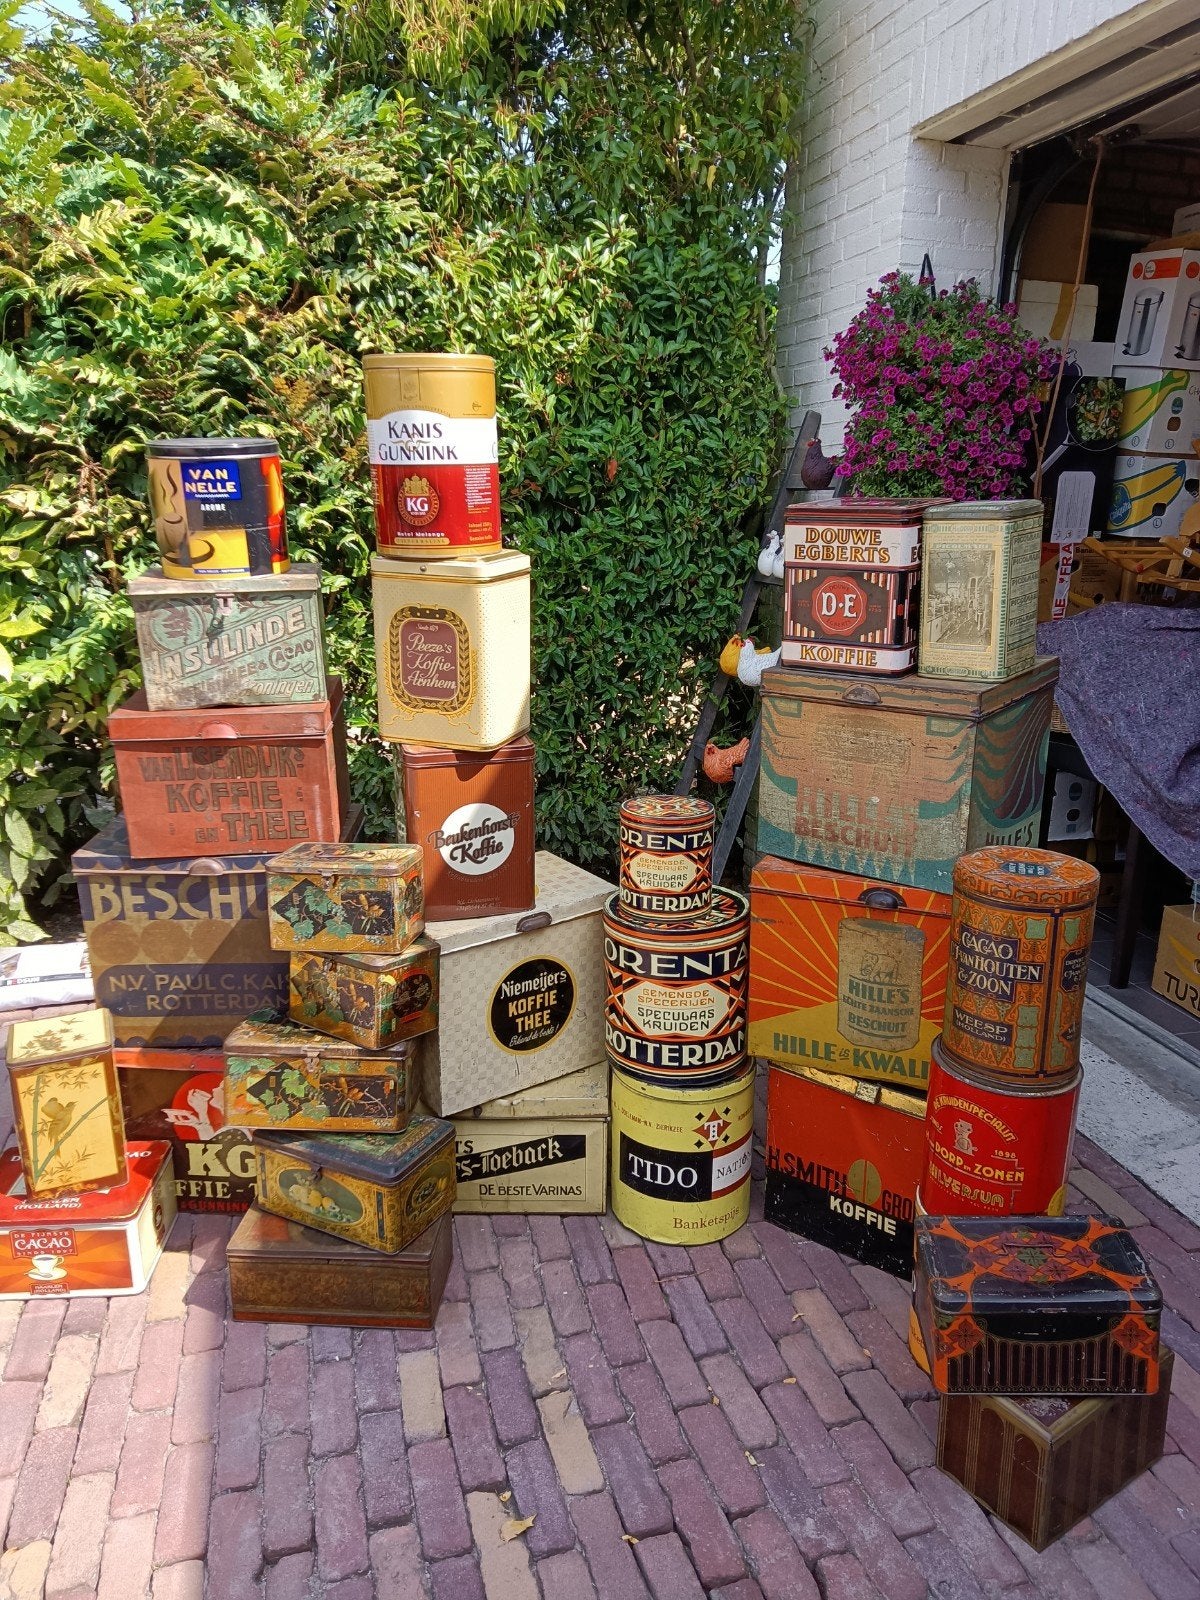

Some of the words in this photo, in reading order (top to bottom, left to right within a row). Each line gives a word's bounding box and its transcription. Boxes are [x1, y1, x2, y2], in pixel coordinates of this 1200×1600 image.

[387, 421, 443, 439] KANIS
[378, 443, 458, 461] GUNNINK
[188, 468, 229, 480] VAN
[184, 481, 238, 493] NELLE
[406, 497, 429, 512] KG
[805, 527, 882, 546] DOUWE
[794, 544, 891, 563] EGBERTS
[406, 632, 453, 654] Peeze's
[406, 651, 456, 679] Koffie
[800, 644, 878, 667] KOFFIE
[403, 670, 457, 690] Arnhem
[166, 780, 283, 813] KOFFIE
[194, 827, 220, 843] EN
[221, 810, 310, 842] THEE
[620, 825, 713, 851] ORENTA
[449, 835, 504, 865] Koffie
[636, 870, 688, 881] SPECULAAS
[639, 879, 684, 888] KRUIDEN
[961, 931, 1014, 960] CACAO
[604, 937, 748, 978] ORENTA
[974, 954, 1041, 981] HOUTEN
[155, 973, 216, 992] PAUL
[501, 970, 567, 999] Niemeijers
[642, 988, 710, 999] GEMENGDE
[967, 970, 1012, 996] ZOON
[1163, 970, 1200, 1012] TUR
[508, 990, 558, 1018] KOFFIE
[637, 995, 715, 1007] SPECERIJEN
[515, 1009, 551, 1034] THEE
[637, 1006, 715, 1021] SPECULAAS
[848, 1011, 908, 1033] BESCHUIT
[954, 1008, 1008, 1034] WEESP
[642, 1018, 710, 1032] KRUIDEN
[956, 1021, 1006, 1042] (HOLLAND)
[772, 1032, 837, 1063] HILLE
[939, 1095, 1017, 1143] KRUIDENSPECIALIST
[186, 1143, 257, 1178] KG
[934, 1141, 964, 1167] DORP
[973, 1163, 1025, 1182] ZONEN
[994, 1149, 1017, 1159] 1898
[628, 1152, 699, 1189] TIDO
[479, 1183, 496, 1196] DE
[498, 1184, 532, 1196] BESTE
[532, 1183, 583, 1196] VARINAS
[928, 1160, 1004, 1209] HILVERSUM
[14, 1202, 83, 1210] (HOLLAND)
[188, 1201, 249, 1213] GUNNINK
[829, 1195, 897, 1237] KOFFIE
[14, 1237, 73, 1250] CACAO
